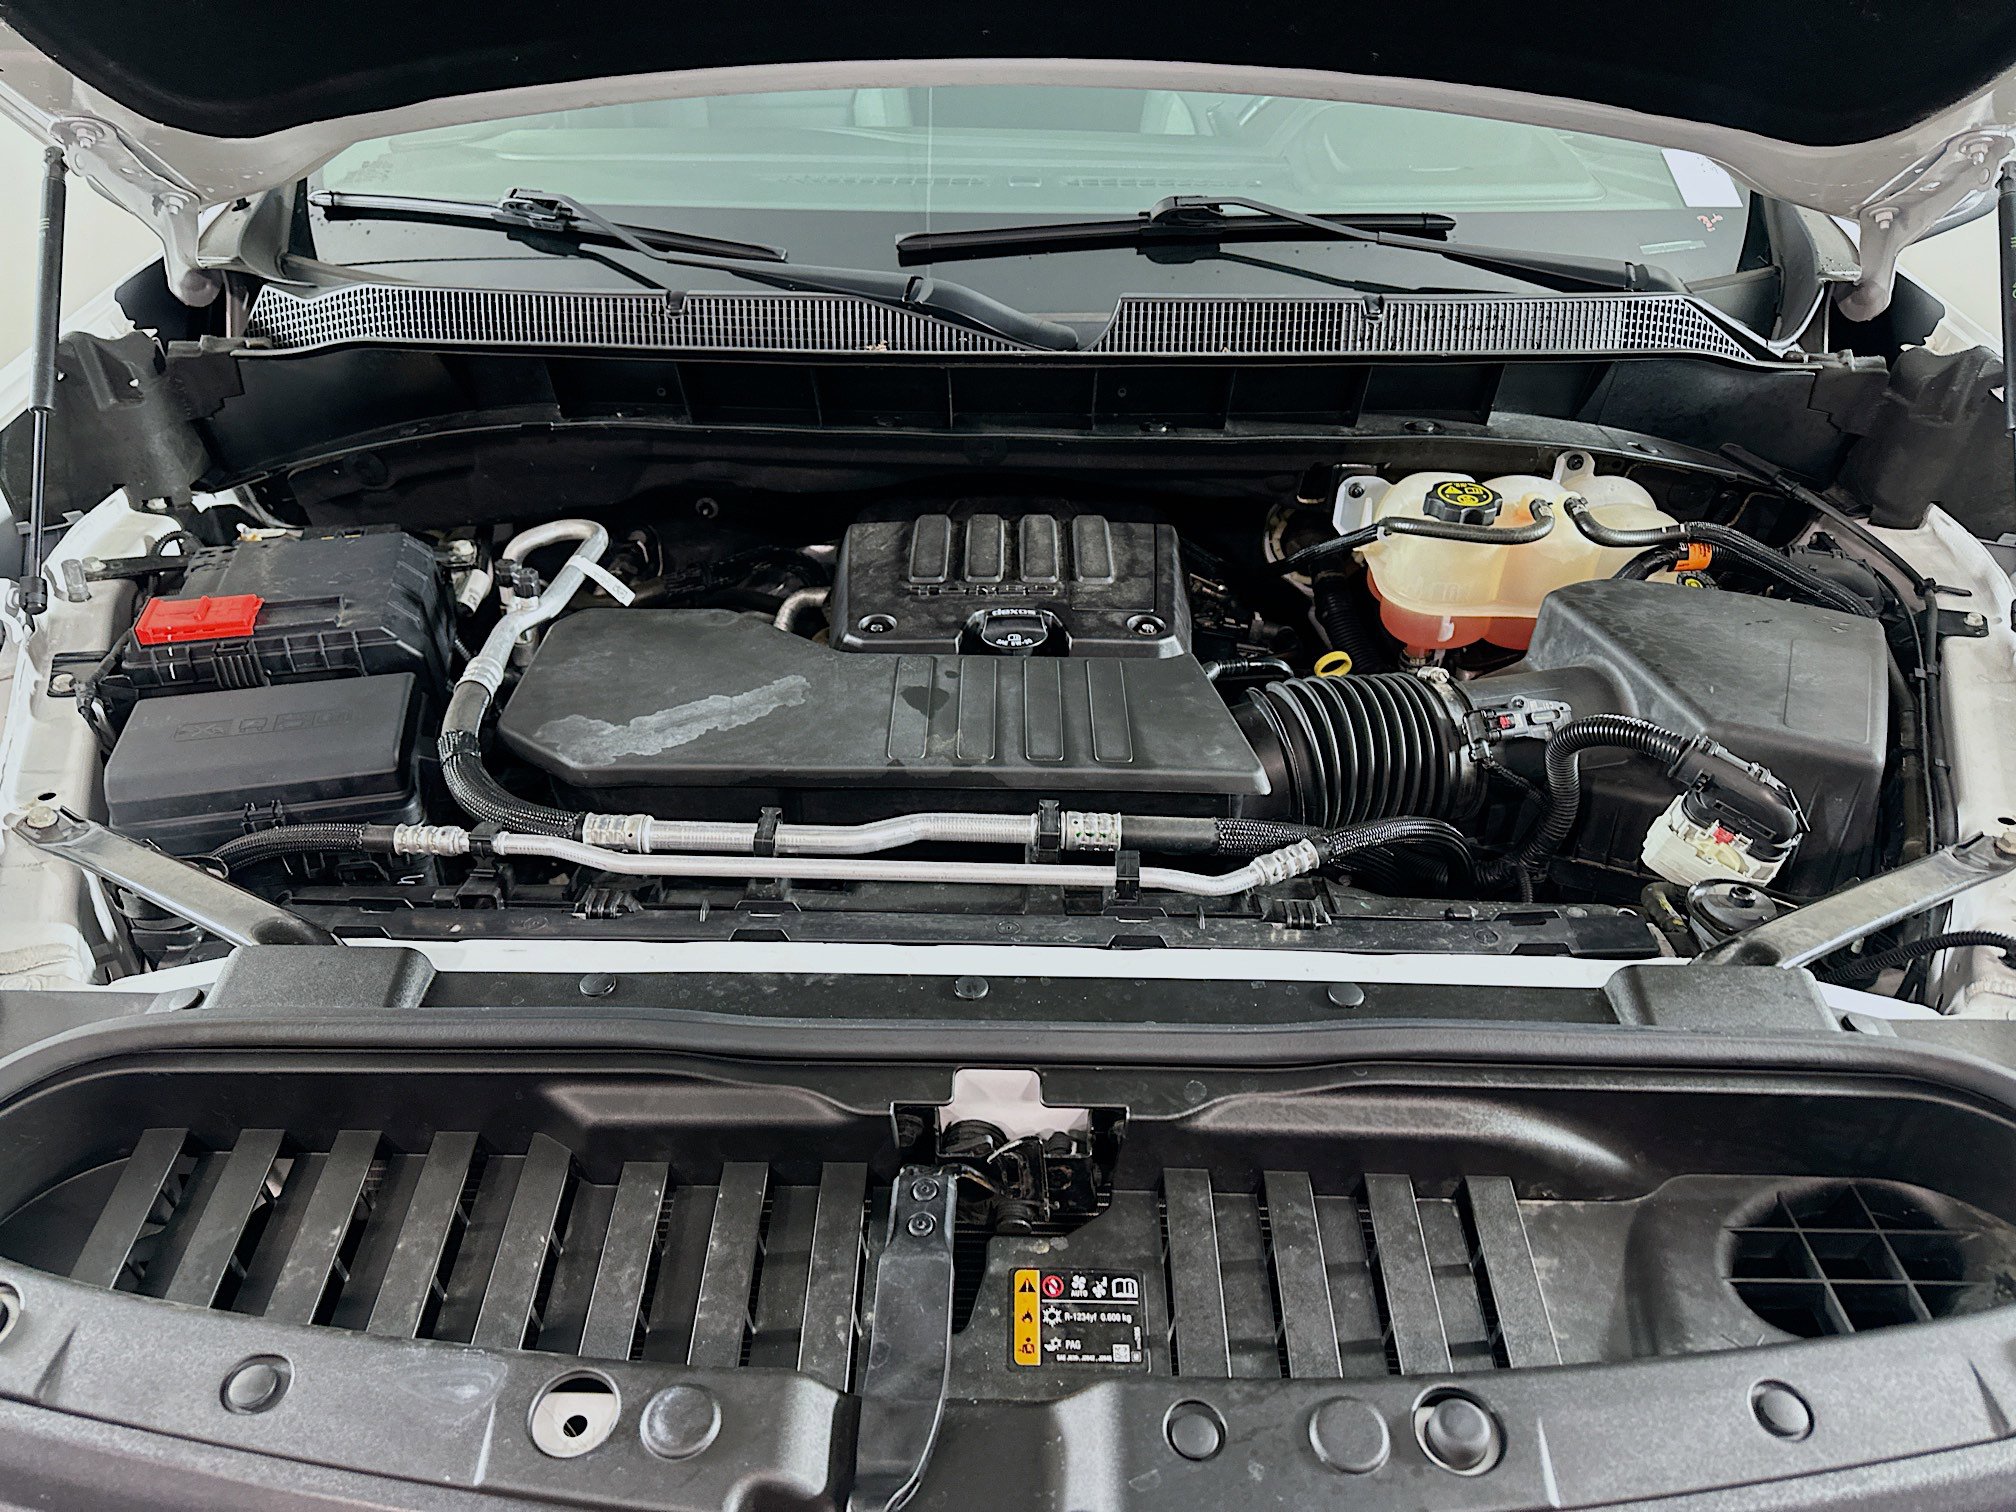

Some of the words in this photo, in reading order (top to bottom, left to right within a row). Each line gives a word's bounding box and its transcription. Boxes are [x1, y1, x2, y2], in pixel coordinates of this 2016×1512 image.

[1071, 1290, 1088, 1298] AUTO
[1064, 1312, 1097, 1323] R-1234yf
[1122, 1313, 1132, 1324] kg
[1065, 1340, 1081, 1350] PAG
